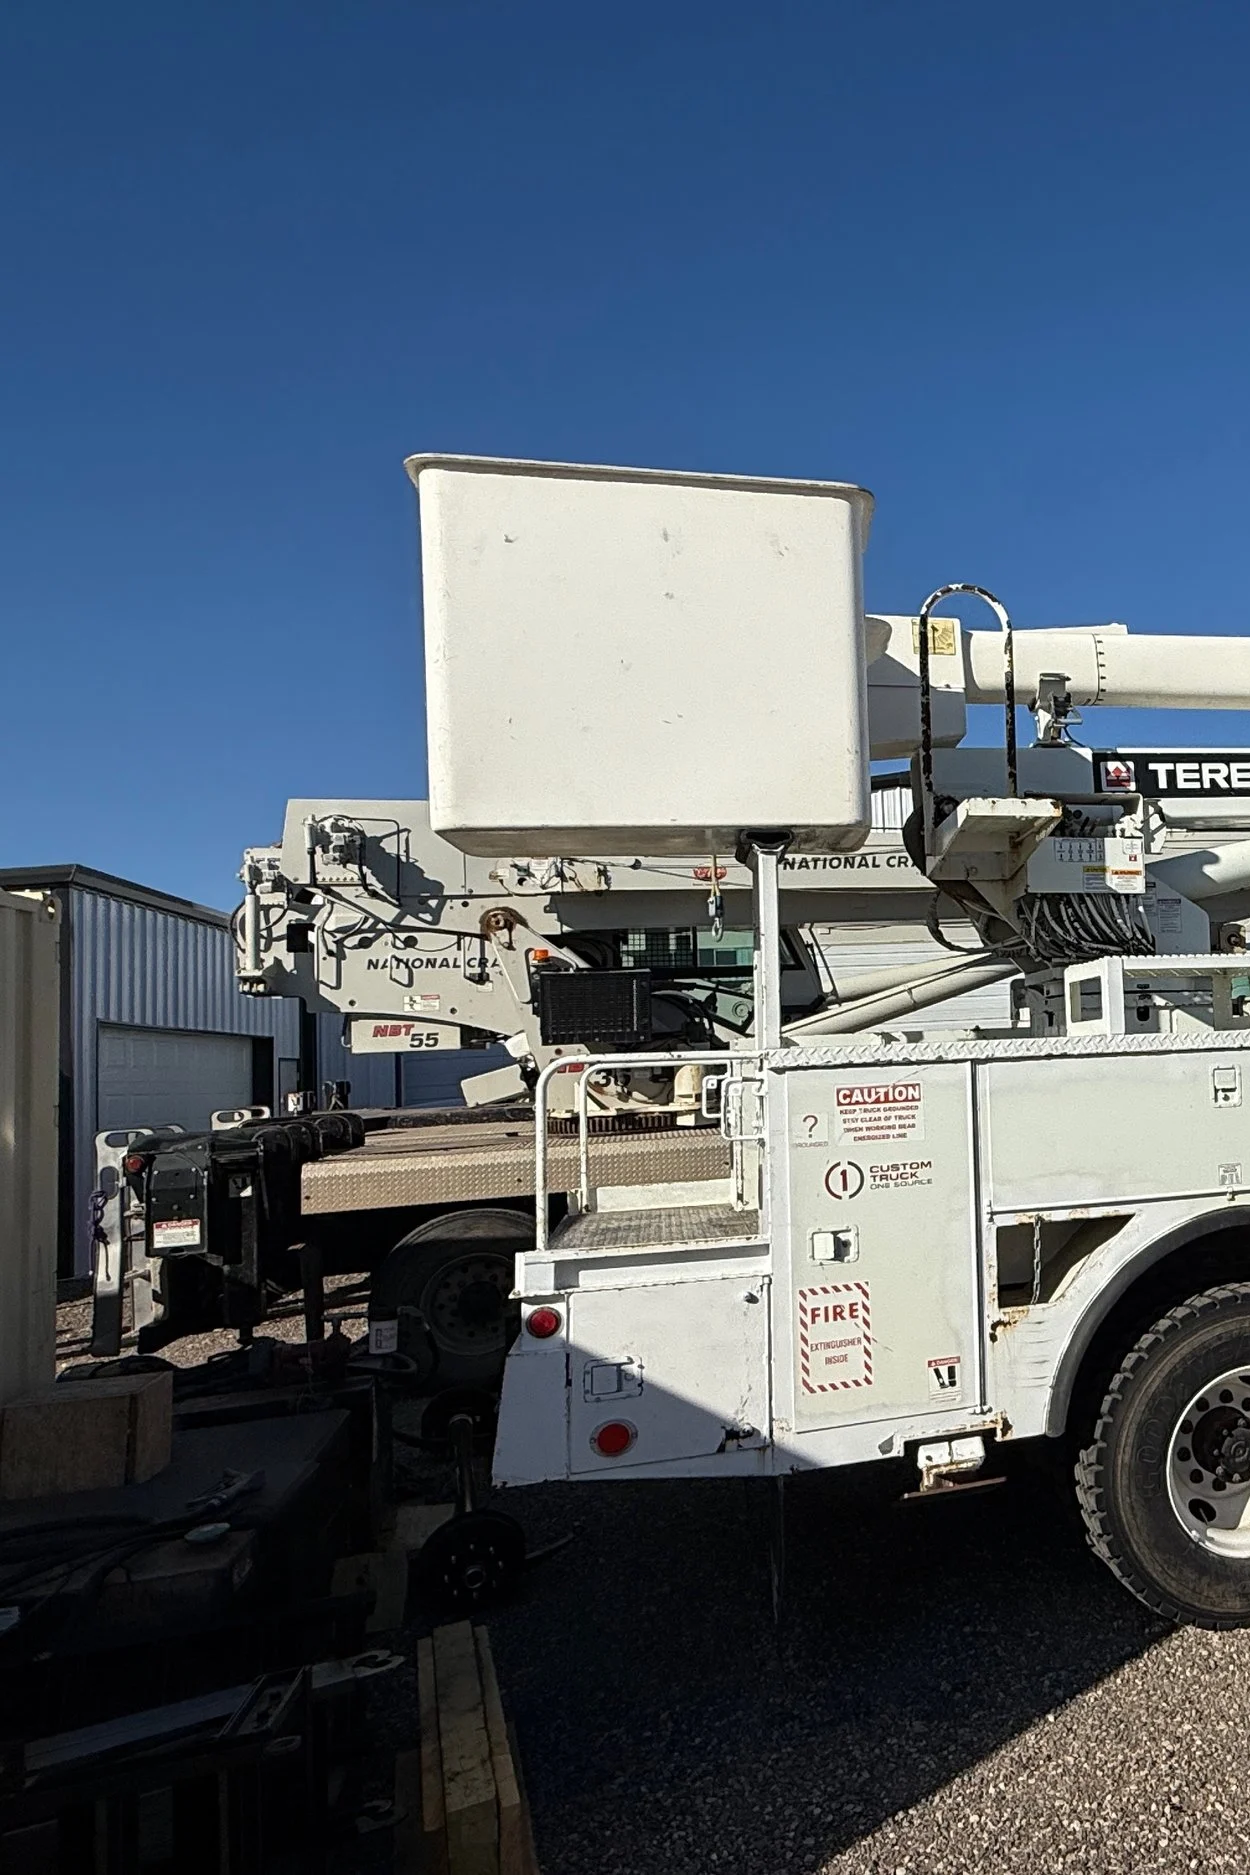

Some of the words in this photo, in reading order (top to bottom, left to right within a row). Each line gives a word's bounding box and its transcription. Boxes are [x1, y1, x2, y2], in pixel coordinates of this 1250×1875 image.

[782, 855, 881, 871] NATIONAL
[366, 957, 461, 970] NATIONAL
[372, 1024, 415, 1038] NBT
[409, 1032, 440, 1048] 55
[838, 1085, 921, 1104] CAUTION
[894, 1113, 916, 1121] TRUCK
[802, 1114, 819, 1139] ?
[869, 1160, 932, 1174] CUSTOM
[869, 1171, 920, 1183] TRUCK
[893, 1178, 933, 1188] SOURCE
[810, 1302, 860, 1325] FIRE
[810, 1336, 862, 1353] EXTINGUISHER
[824, 1353, 849, 1366] INSIDE
